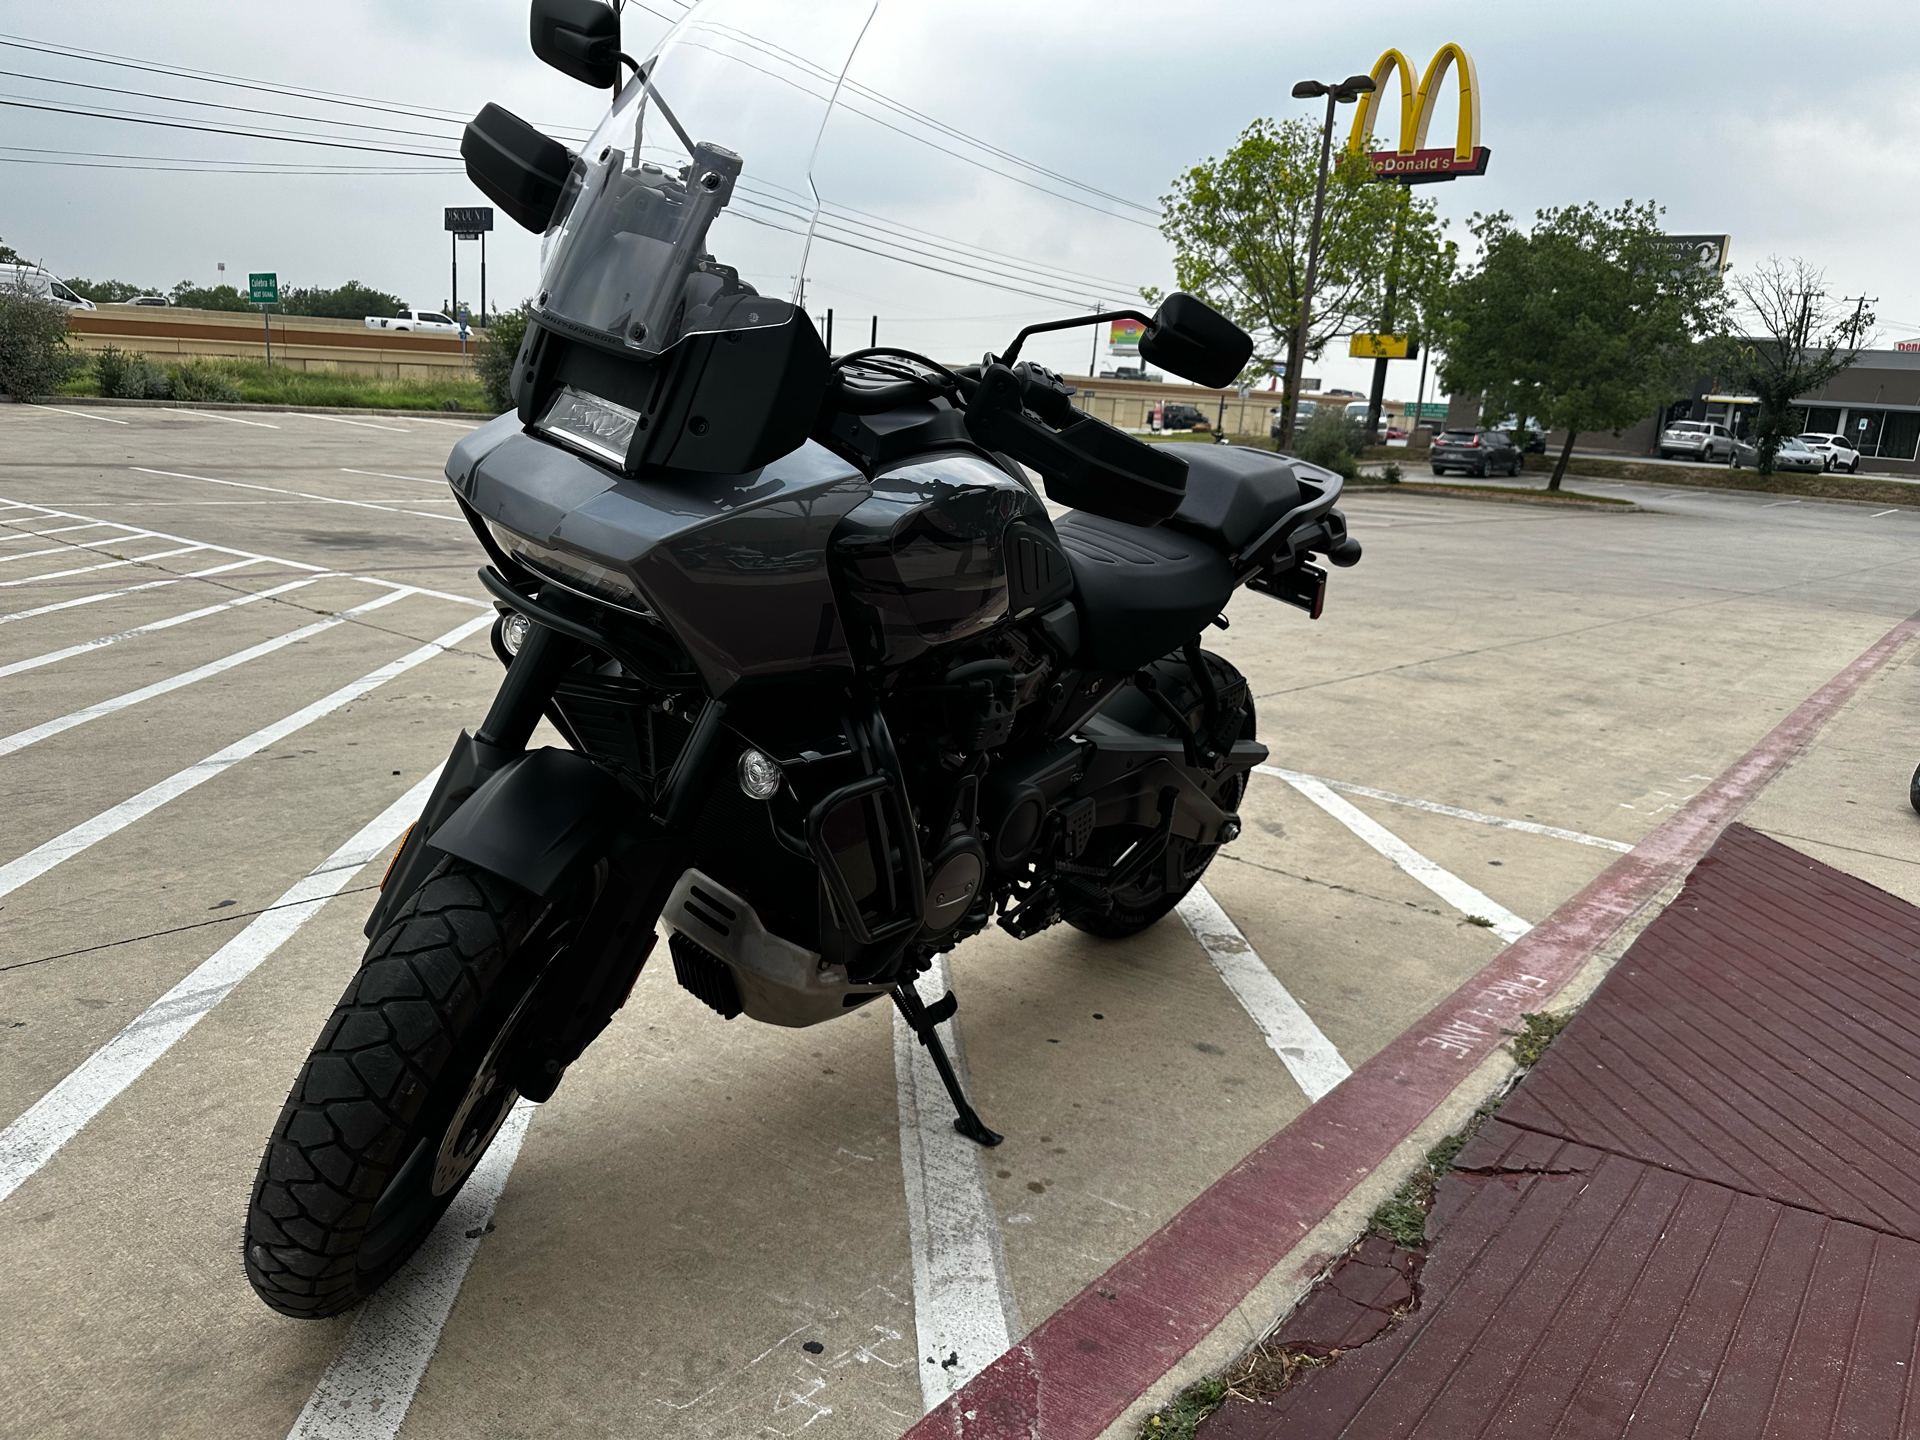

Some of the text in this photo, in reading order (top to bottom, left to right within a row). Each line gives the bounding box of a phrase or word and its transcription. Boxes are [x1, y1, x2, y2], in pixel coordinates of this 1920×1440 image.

[446, 209, 486, 221] DISCOUNT
[251, 279, 276, 288] Culebra Rd
[1474, 972, 1549, 1006] FIRE
